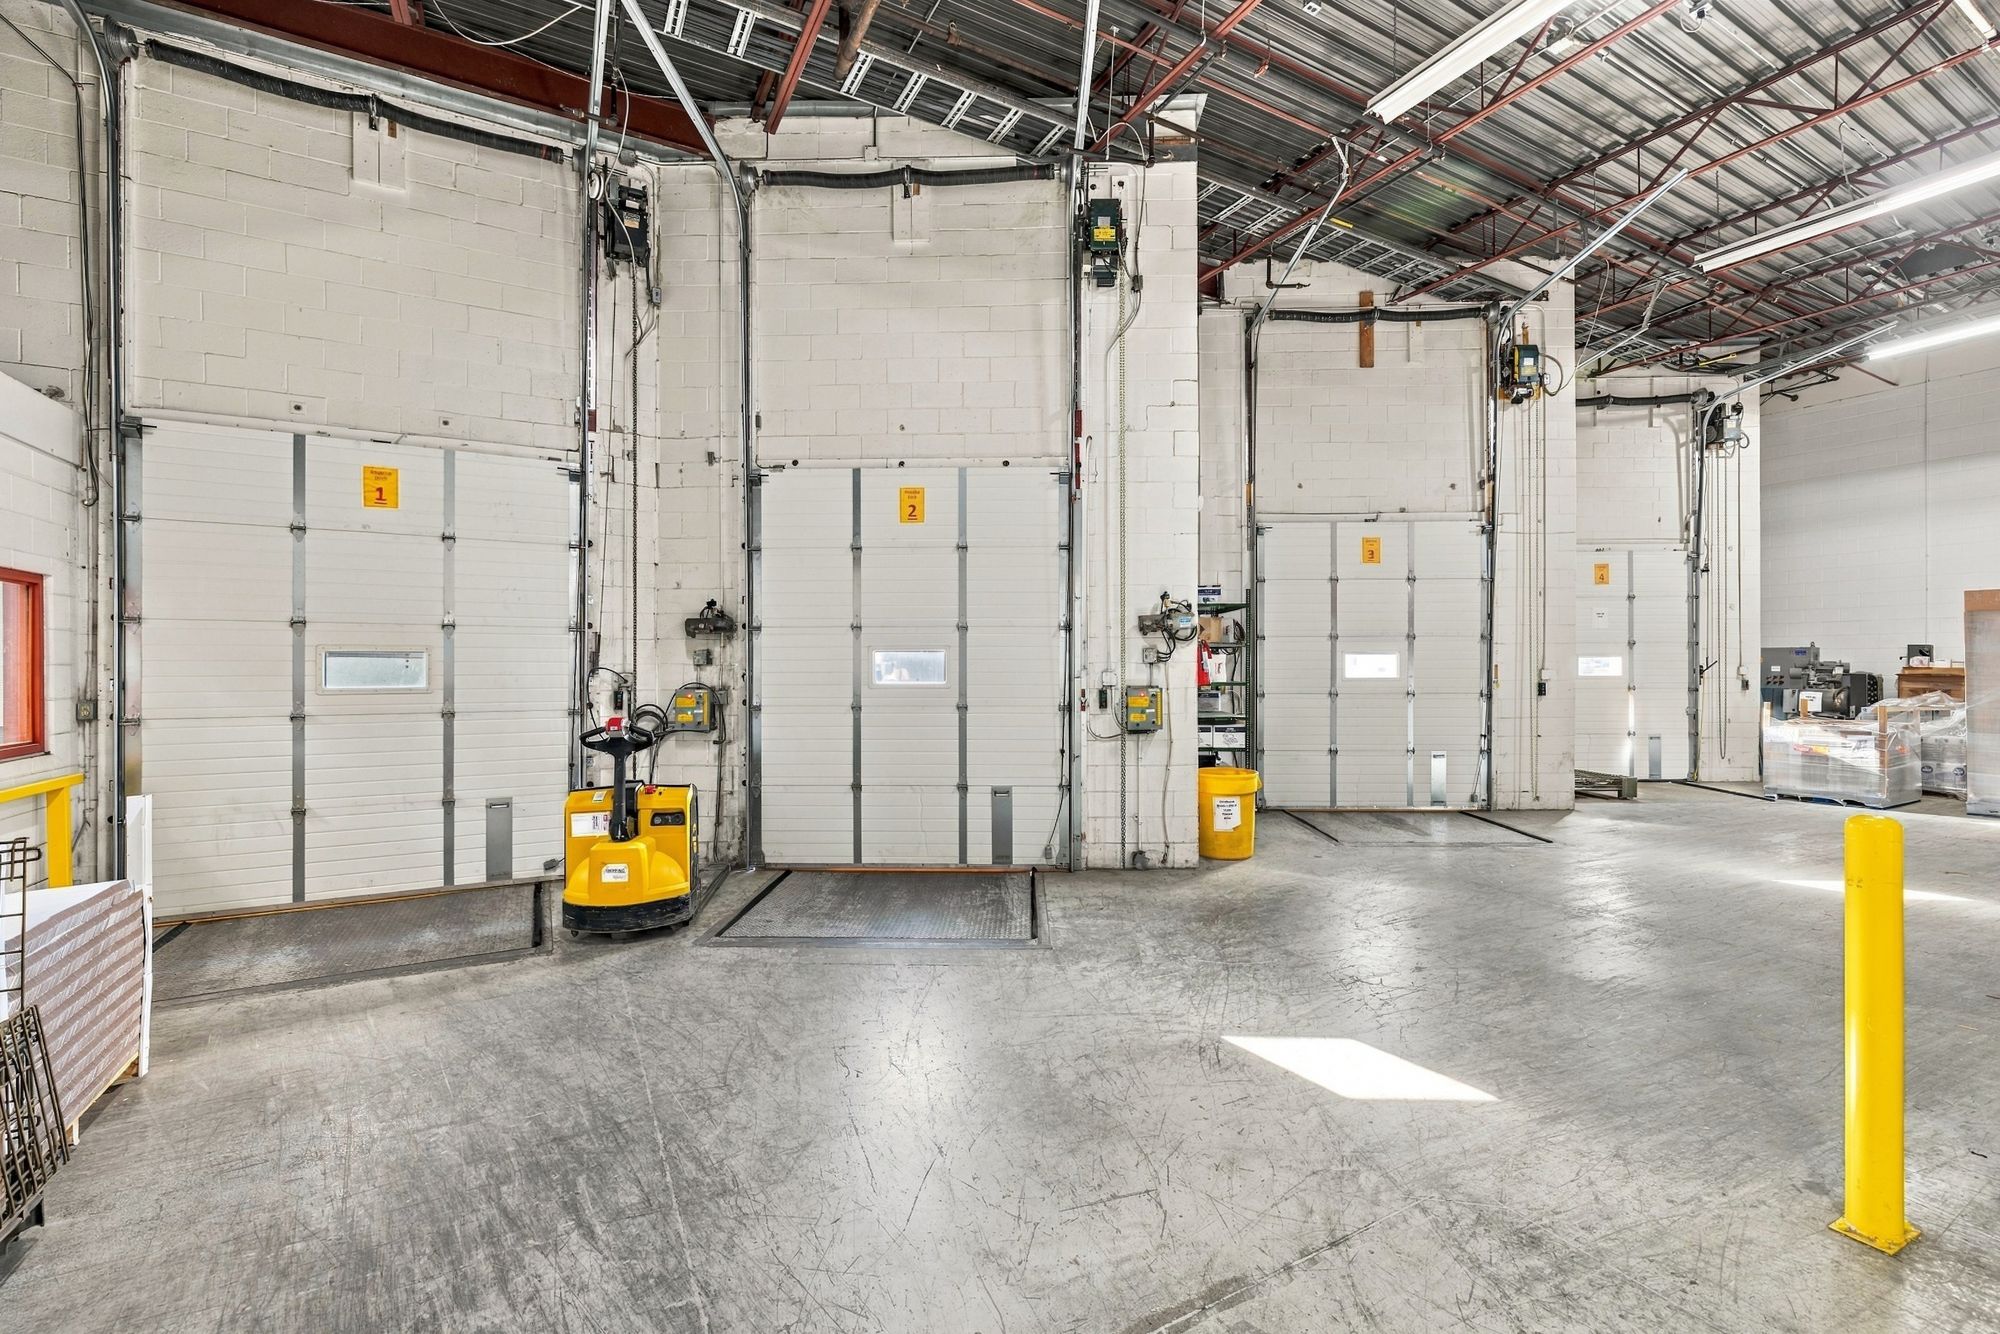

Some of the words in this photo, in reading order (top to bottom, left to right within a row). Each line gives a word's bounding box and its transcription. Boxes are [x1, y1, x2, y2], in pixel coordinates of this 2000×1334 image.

[375, 486, 387, 501] 1
[908, 504, 917, 517] 2
[1367, 549, 1375, 560] 3
[1599, 573, 1605, 581] 4
